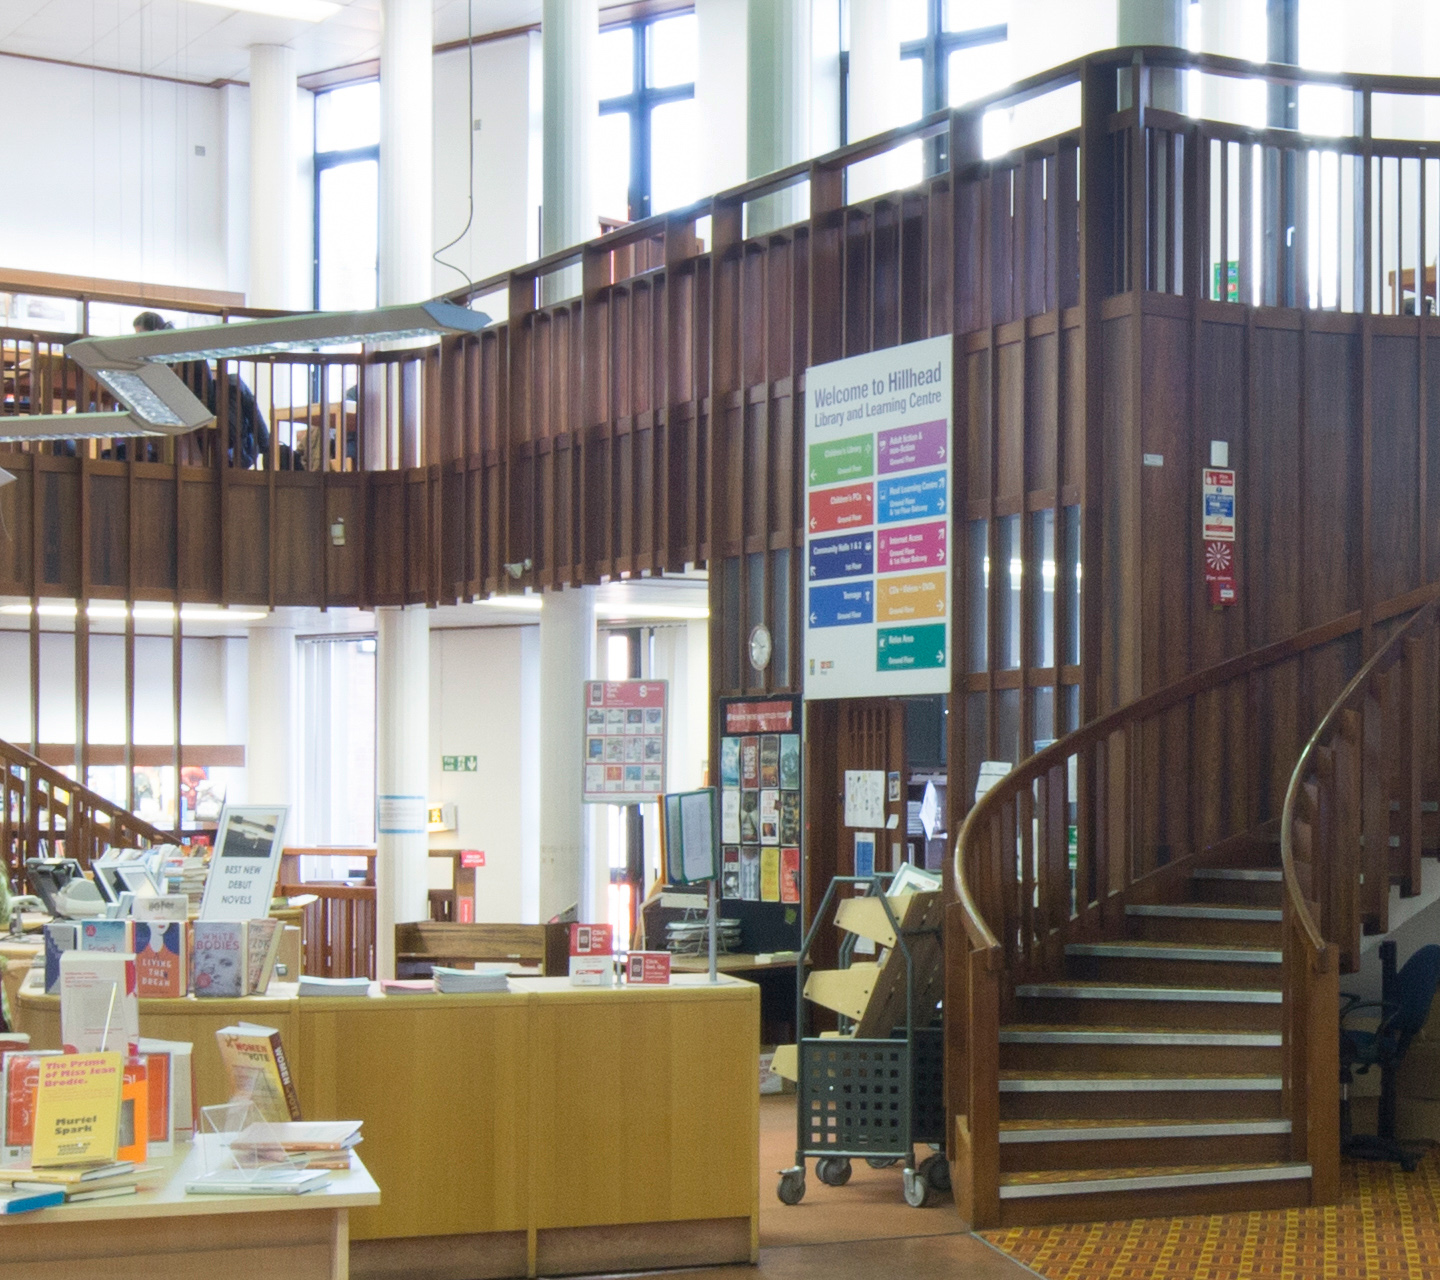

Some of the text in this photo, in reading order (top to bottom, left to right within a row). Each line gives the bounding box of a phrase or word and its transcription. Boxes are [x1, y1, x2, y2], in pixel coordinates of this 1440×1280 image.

[814, 361, 942, 409] Welcome to Hillhead
[814, 391, 942, 428] Library and Learning Centre
[225, 865, 262, 874] BEST NEW
[227, 880, 252, 890] DEBUT
[221, 895, 252, 905] NOVELS
[202, 933, 235, 942] WHITE
[196, 940, 240, 951] BODIES
[142, 958, 172, 969] LIVING
[234, 1041, 267, 1053] WOMEN
[248, 1052, 270, 1062] VOTE
[45, 1057, 106, 1070] The Prime
[274, 1046, 290, 1085] WOMEN
[45, 1065, 116, 1079] of Miss Jean
[44, 1076, 88, 1088] Brodie.
[56, 1115, 97, 1126] Muriel
[55, 1124, 92, 1136] Spark
